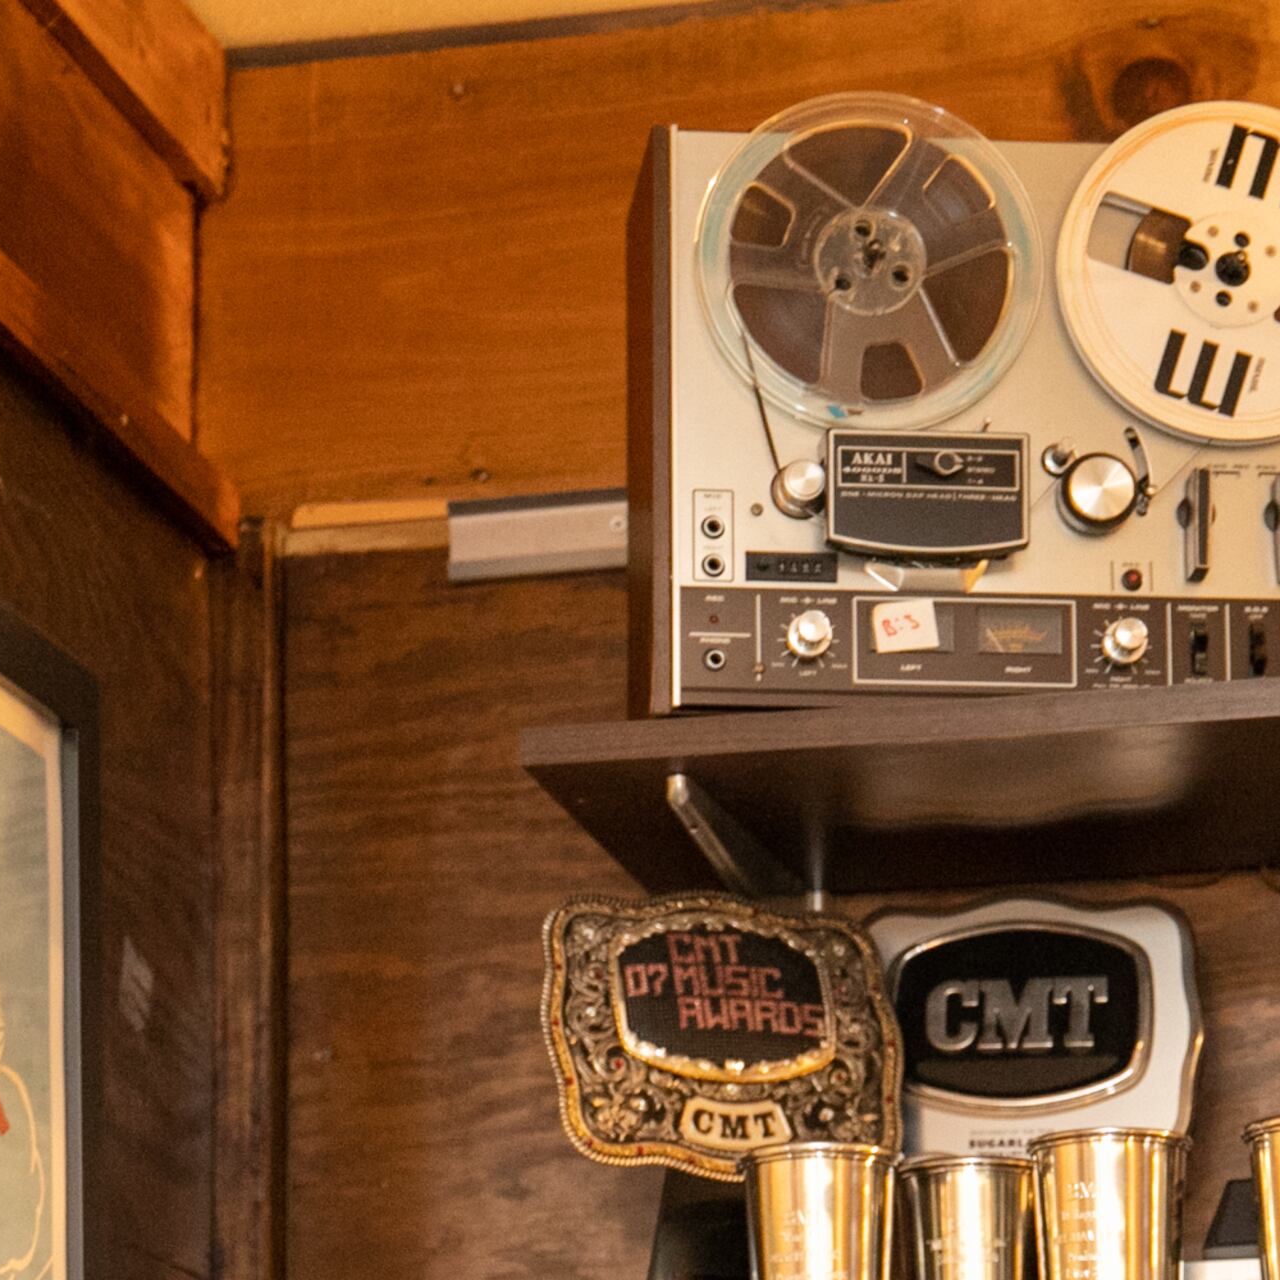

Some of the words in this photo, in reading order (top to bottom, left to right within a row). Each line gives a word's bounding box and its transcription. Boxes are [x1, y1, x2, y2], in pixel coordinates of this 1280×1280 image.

[851, 452, 893, 466] AKAI
[667, 933, 742, 965] CMT
[673, 965, 785, 999] MUSIC
[679, 997, 826, 1037] AWARDS
[925, 975, 1109, 1053] CMT
[692, 1109, 776, 1140] CMT
[968, 1138, 1024, 1148] SUGARL
